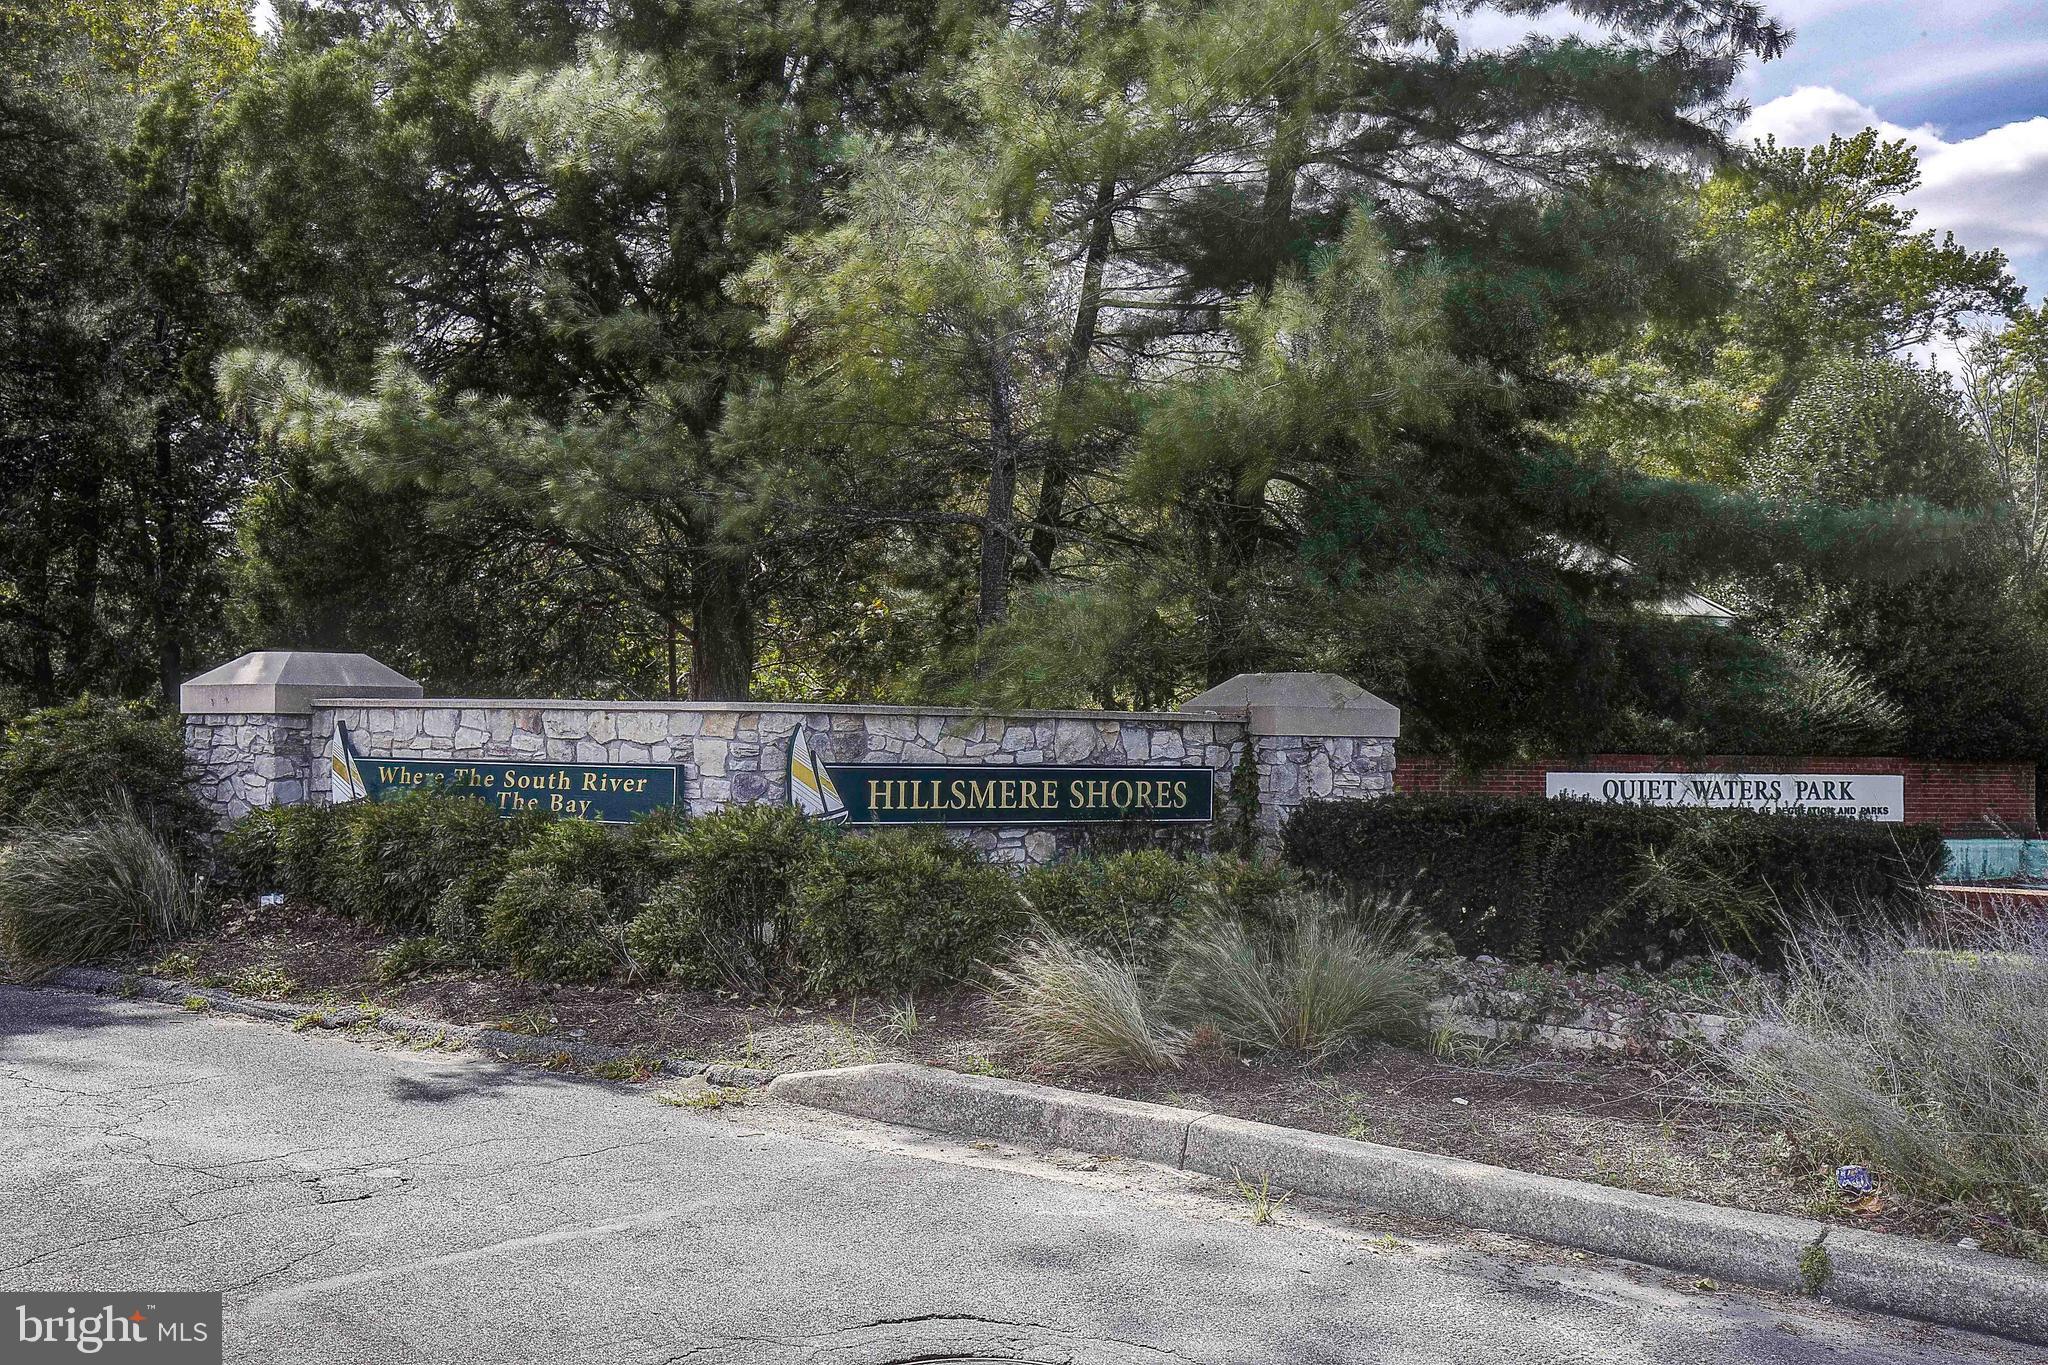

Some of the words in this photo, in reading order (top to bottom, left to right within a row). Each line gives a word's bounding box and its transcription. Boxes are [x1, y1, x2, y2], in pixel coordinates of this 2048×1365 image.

[378, 766, 445, 785] Whee
[454, 768, 495, 788] The
[503, 769, 572, 791] South
[580, 772, 648, 793] River
[1602, 779, 1677, 801] QUIET
[1691, 780, 1782, 801] WATERS
[1795, 780, 1856, 801] PARK
[496, 791, 539, 811] The
[550, 793, 592, 818] Bay
[867, 779, 1060, 810] HILLSMERE
[1069, 780, 1189, 809] SHORES
[1836, 806, 1857, 815] AND
[1860, 806, 1890, 816] PARKS
